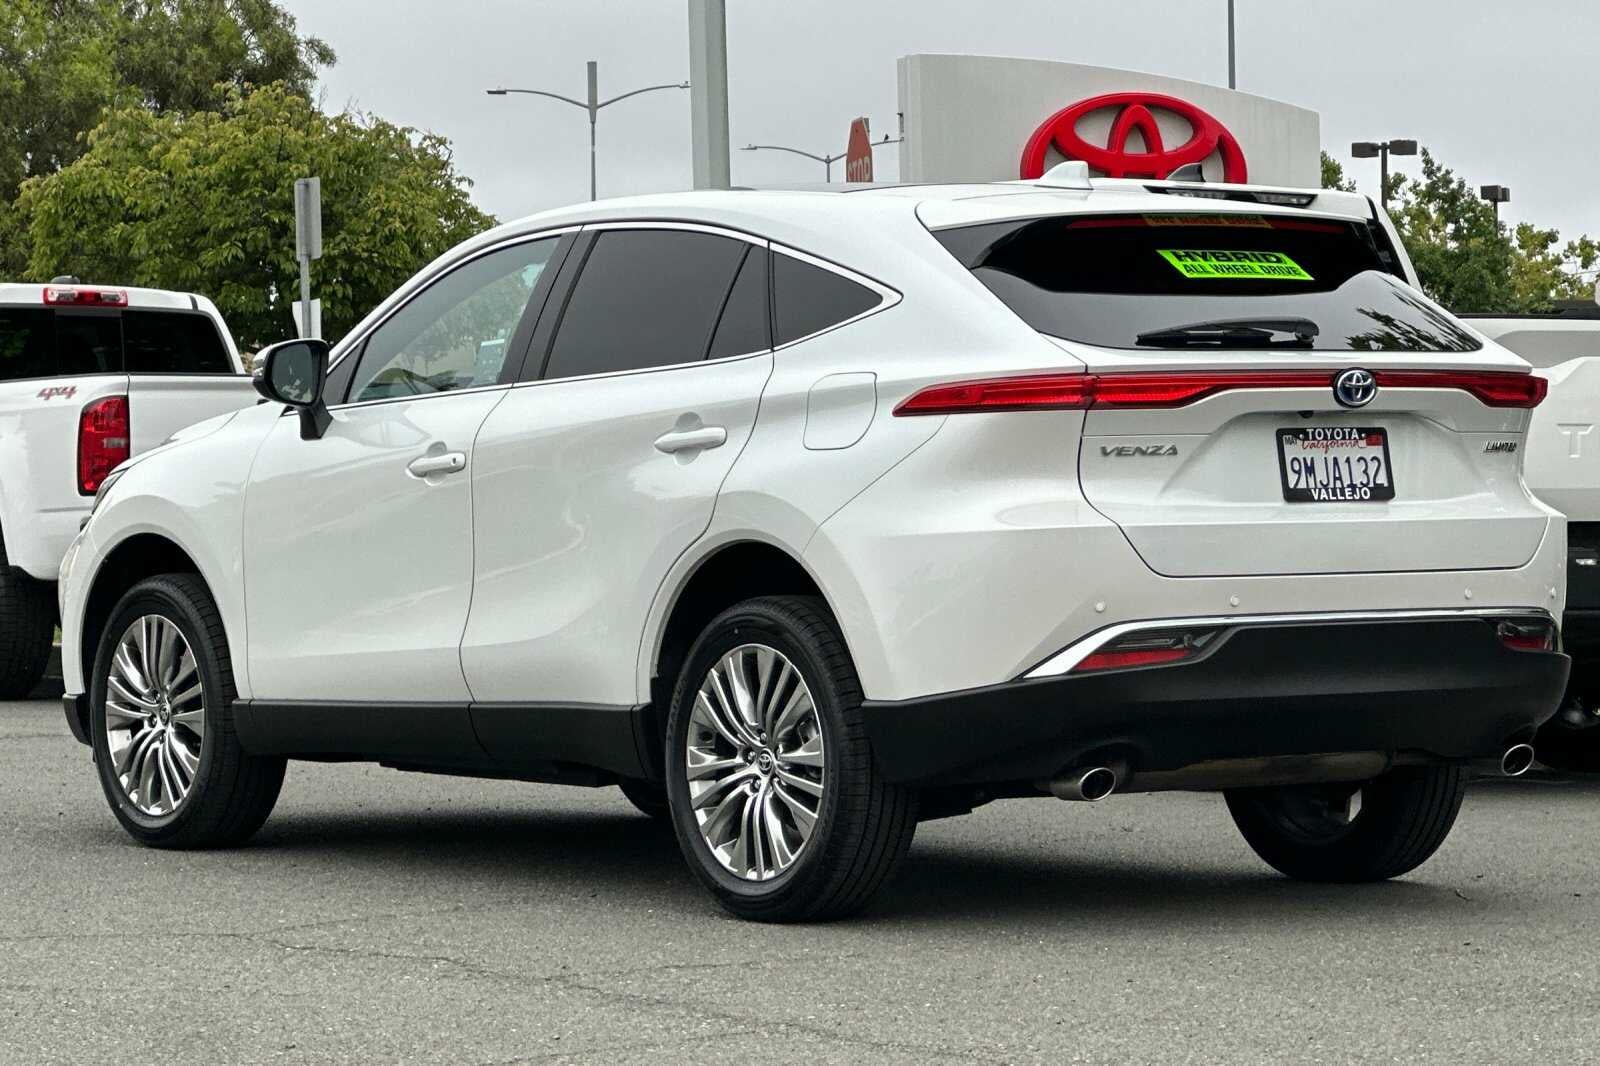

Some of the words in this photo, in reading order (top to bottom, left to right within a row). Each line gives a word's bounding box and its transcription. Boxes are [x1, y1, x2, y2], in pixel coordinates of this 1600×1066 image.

[1173, 250, 1284, 264] HYBRID
[1183, 263, 1209, 275] ALL
[1210, 263, 1258, 276] WHEEL
[1260, 264, 1302, 277] DRIVE
[1306, 428, 1360, 441] TOYOTA
[1100, 444, 1178, 457] VENZA
[1301, 440, 1366, 454] California
[1290, 456, 1383, 489] 9MJA132
[1311, 487, 1371, 500] VALLEJO
